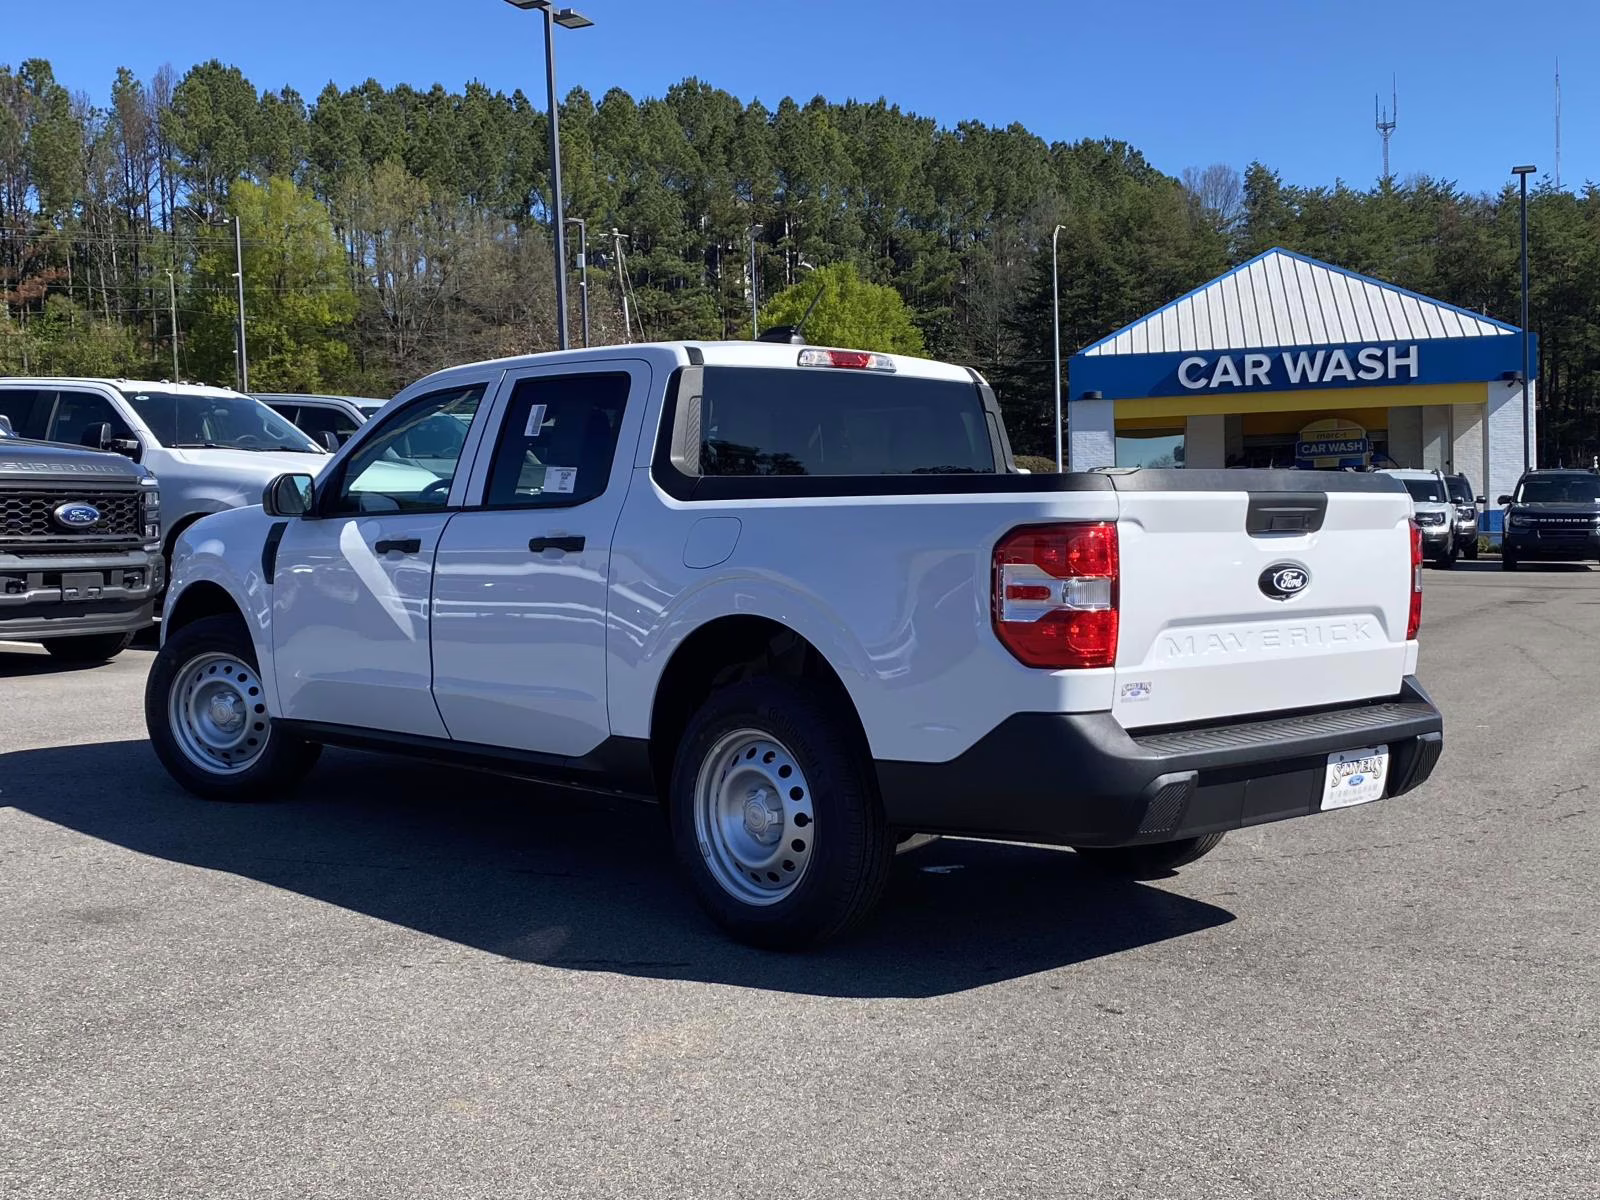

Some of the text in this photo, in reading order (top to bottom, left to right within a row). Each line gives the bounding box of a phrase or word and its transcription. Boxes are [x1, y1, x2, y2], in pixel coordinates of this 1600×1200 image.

[1178, 345, 1418, 389] CAR WASH
[1301, 441, 1363, 454] CAR WASH
[1280, 572, 1304, 588] Ford
[1165, 620, 1373, 658] MAVERICK
[1331, 757, 1383, 788] STIVERS
